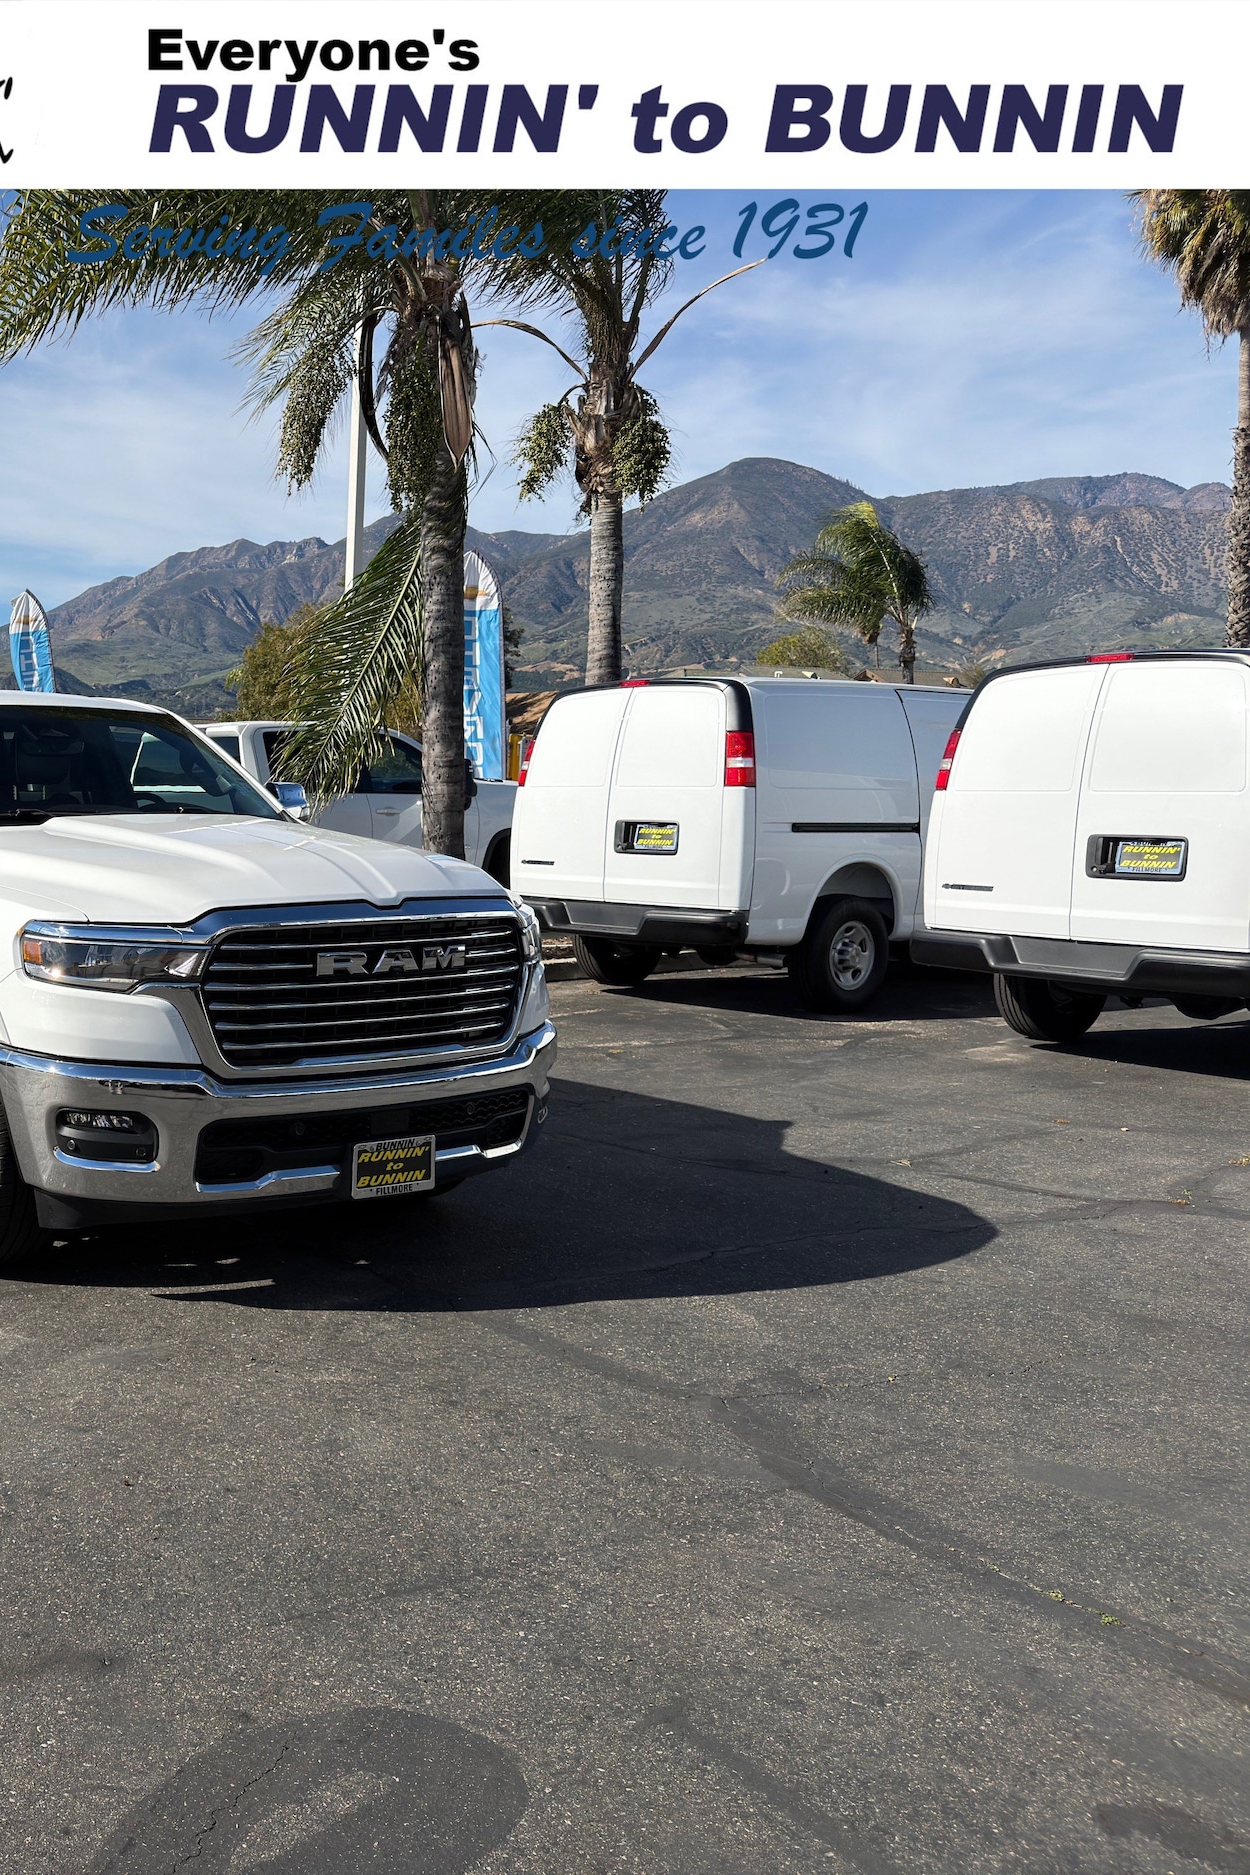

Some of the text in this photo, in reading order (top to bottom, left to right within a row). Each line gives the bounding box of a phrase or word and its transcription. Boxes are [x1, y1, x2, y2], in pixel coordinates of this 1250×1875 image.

[1120, 860, 1177, 868] BUNNIN
[316, 944, 466, 976] RAM
[376, 1139, 416, 1151] BUNNIN
[358, 1146, 430, 1163] RUNNIN'
[386, 1162, 404, 1171] to
[356, 1169, 426, 1187] BUNNIN
[376, 1184, 413, 1195] FILLMORE
